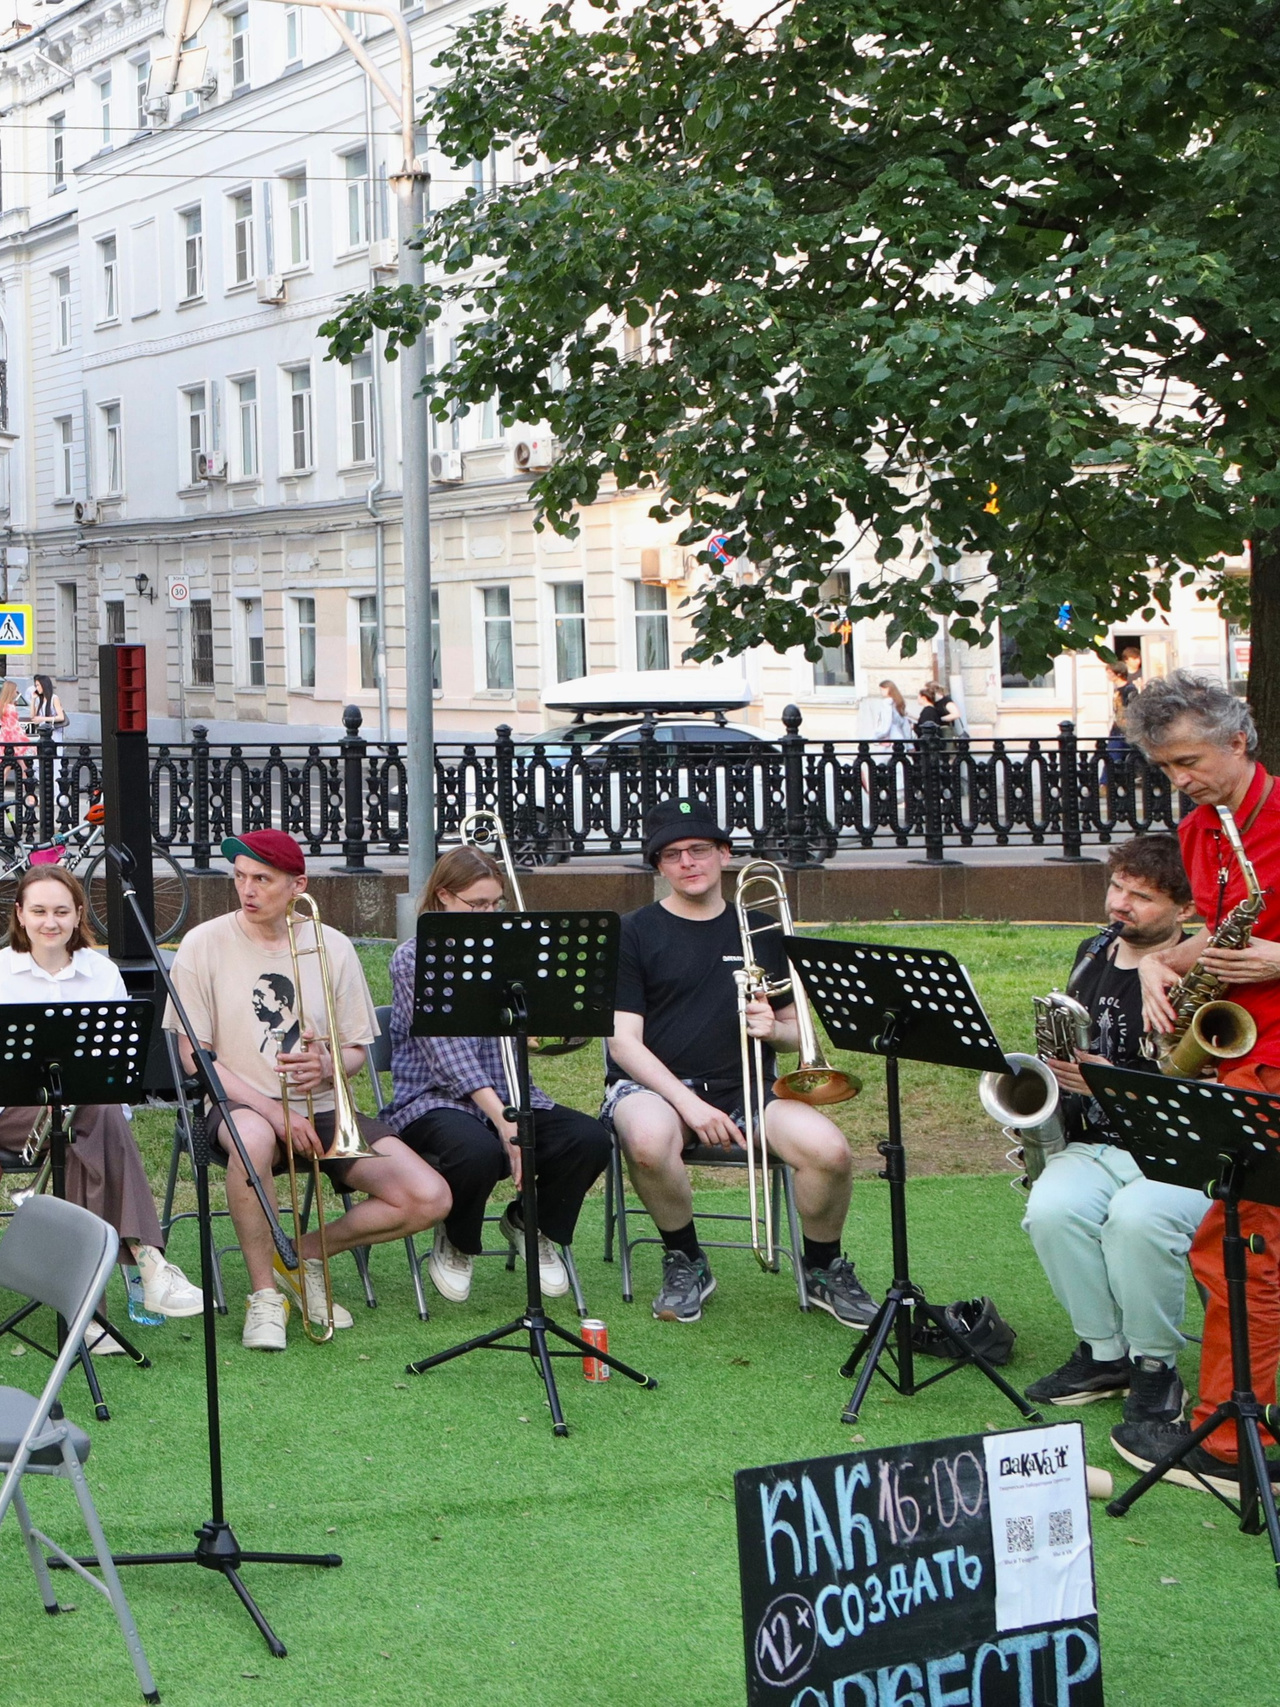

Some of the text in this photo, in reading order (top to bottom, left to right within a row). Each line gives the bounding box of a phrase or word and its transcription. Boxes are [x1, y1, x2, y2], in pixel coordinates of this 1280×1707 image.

[174, 588, 184, 596] 30
[759, 1450, 984, 1585] КАК 16:00
[815, 1545, 983, 1649] СОЗДАТЬ
[790, 1627, 1100, 1707] КЕСТР
